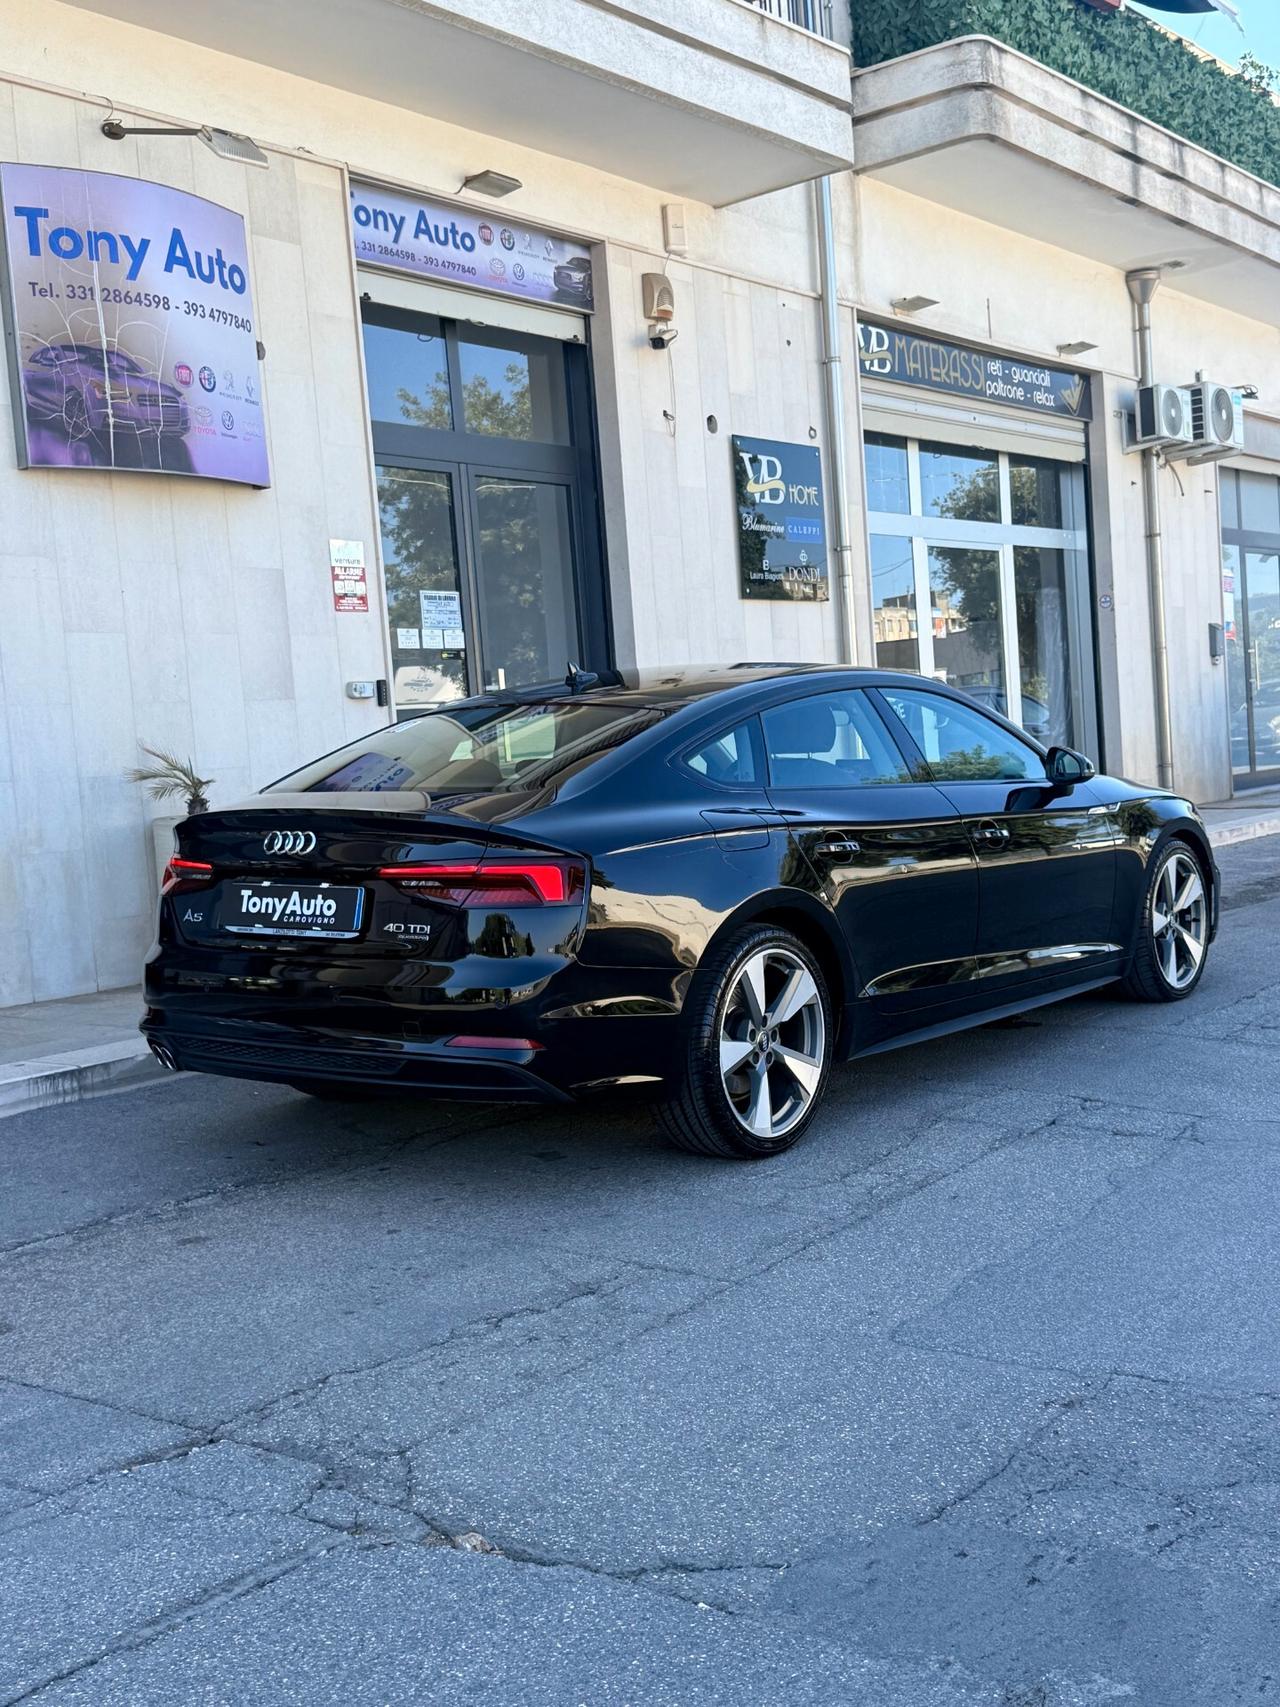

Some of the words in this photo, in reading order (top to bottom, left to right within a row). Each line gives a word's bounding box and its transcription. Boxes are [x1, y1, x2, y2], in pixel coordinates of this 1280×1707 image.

[350, 191, 405, 244] ony
[414, 209, 476, 252] Auto
[14, 206, 151, 281] Tony
[164, 227, 247, 295] Auto
[361, 240, 376, 253] 331
[378, 245, 416, 262] 2864598
[424, 255, 439, 268] 393
[441, 258, 477, 276] 4797840
[28, 281, 60, 299] Tel.
[66, 284, 96, 301] 331
[102, 287, 171, 311] 2864598
[184, 301, 206, 319] 393
[209, 308, 252, 333] 4797840
[894, 335, 986, 392] MATERASSI
[987, 360, 1002, 377] reti
[1012, 368, 1051, 388] guanciali
[986, 380, 1025, 402] poltrone
[1033, 392, 1055, 407] relax
[739, 452, 786, 505] VB
[789, 483, 819, 506] HOME
[742, 513, 785, 534] Blumarine
[787, 524, 820, 537] CALEFFI
[763, 560, 770, 571] B
[788, 567, 821, 582] DONDI
[241, 889, 337, 922] TonyAuto
[283, 915, 336, 924] CAROVIGNO
[384, 923, 404, 933] 40
[408, 924, 431, 935] TDI
